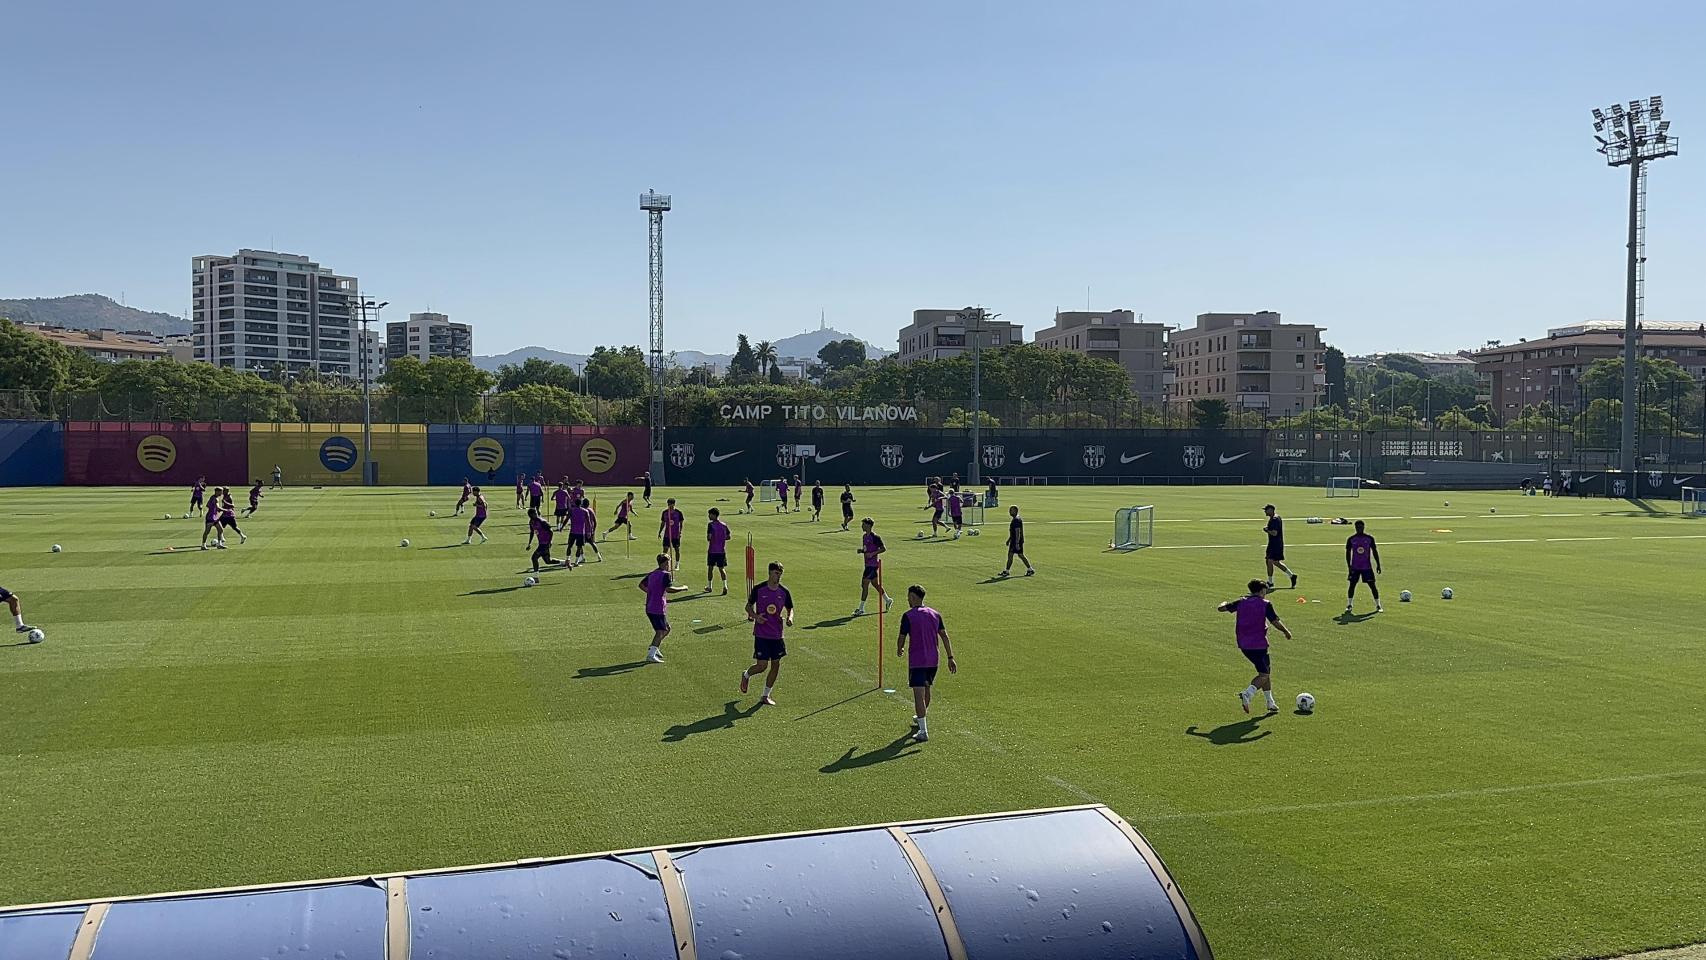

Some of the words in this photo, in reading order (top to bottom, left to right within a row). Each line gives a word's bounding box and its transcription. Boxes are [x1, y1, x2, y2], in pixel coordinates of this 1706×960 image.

[720, 405, 772, 419] CAMP
[781, 405, 825, 420] TITO
[836, 406, 918, 421] VILANOVA
